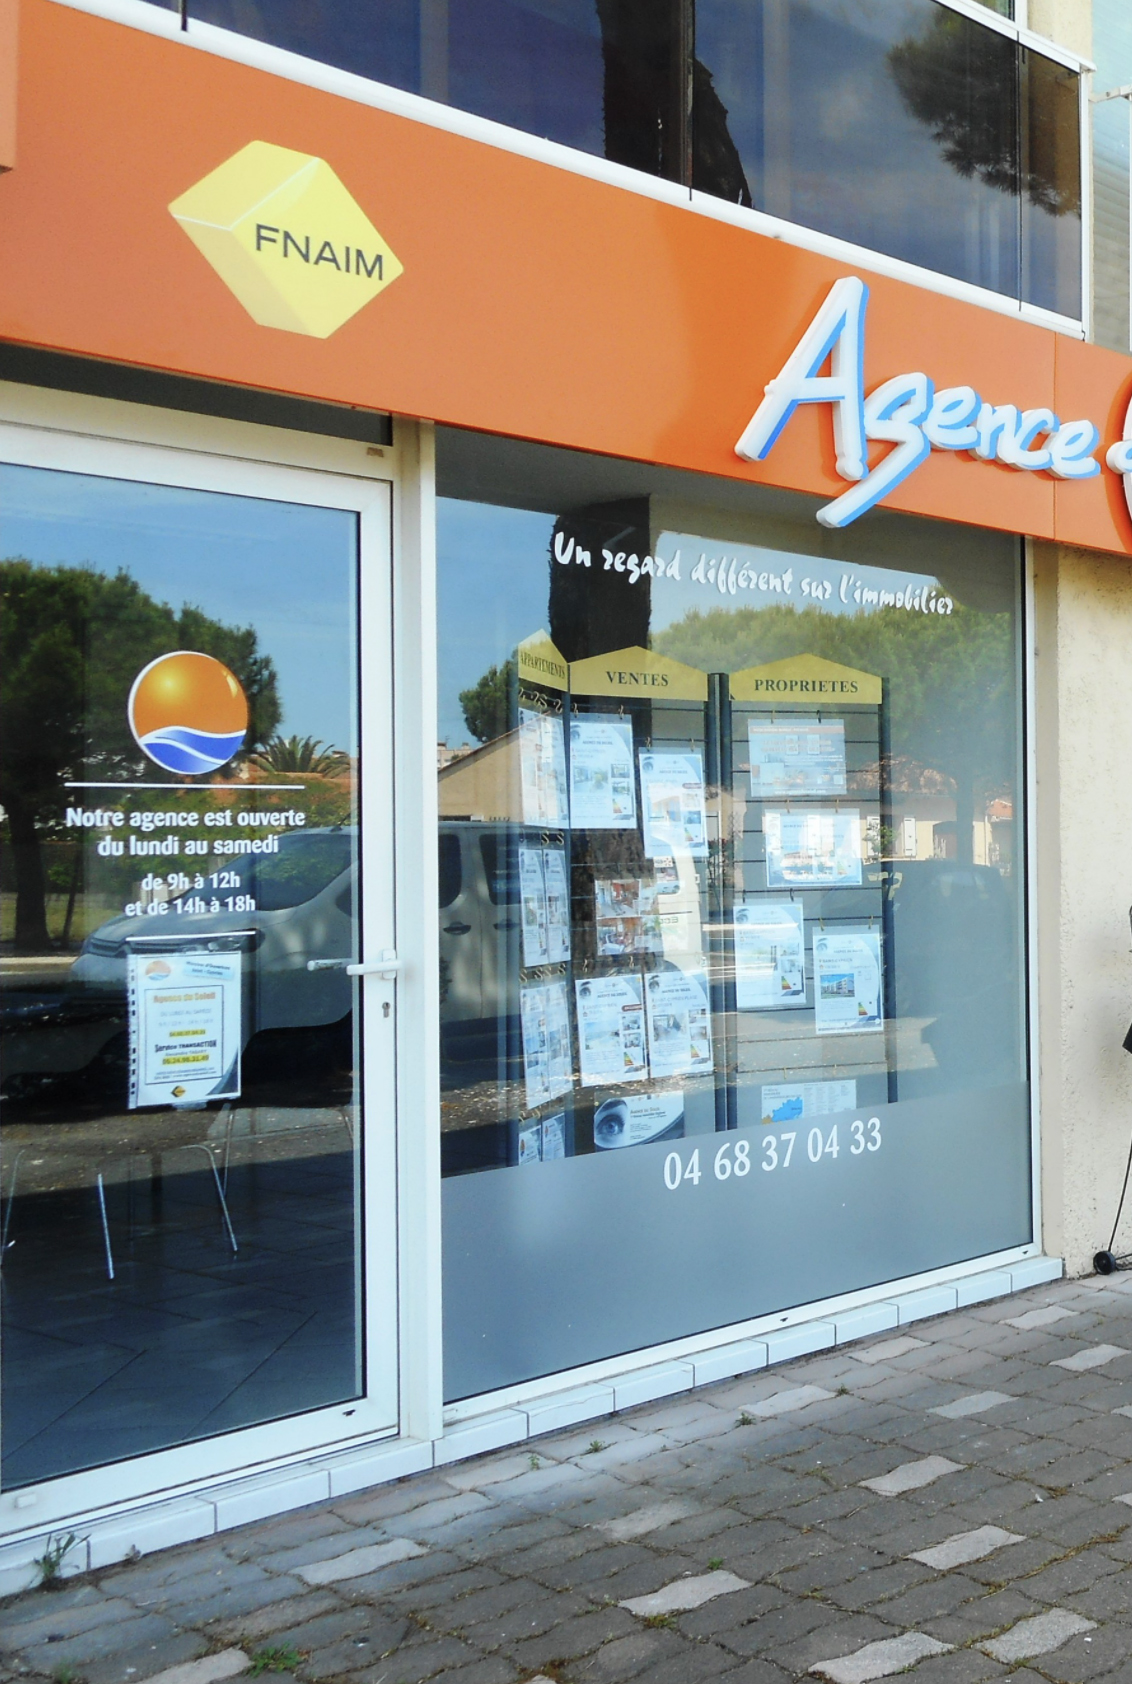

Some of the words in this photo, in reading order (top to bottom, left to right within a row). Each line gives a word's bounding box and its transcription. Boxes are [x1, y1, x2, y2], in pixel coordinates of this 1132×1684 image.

[255, 223, 384, 281] FNAIM
[734, 275, 1101, 529] Agence
[553, 531, 592, 568] Un
[602, 545, 681, 585] regard
[691, 552, 793, 595] différent
[801, 576, 832, 602] sur
[840, 573, 954, 615] l'immobilier
[519, 651, 565, 680] APPARTEMENTS
[606, 671, 669, 687] VENTES
[754, 678, 859, 693] PROPRIETES
[66, 807, 125, 827] Notre
[130, 811, 199, 831] agence
[203, 809, 232, 827] est
[237, 809, 306, 827] ouverte
[97, 835, 124, 856] du
[130, 835, 179, 856] lundi
[184, 840, 208, 855] au
[213, 834, 279, 854] samedi
[141, 874, 163, 891] de
[167, 872, 189, 890] 9h
[194, 872, 204, 889] à
[209, 871, 240, 889] 12h
[125, 900, 142, 917] et
[147, 898, 168, 915] de
[173, 897, 205, 914] 14h
[210, 896, 220, 913] à
[225, 895, 256, 912] 18h
[663, 1148, 702, 1190] 04
[714, 1139, 751, 1180] 68
[762, 1131, 797, 1172] 37
[807, 1124, 841, 1163] 04
[850, 1117, 882, 1155] 33
